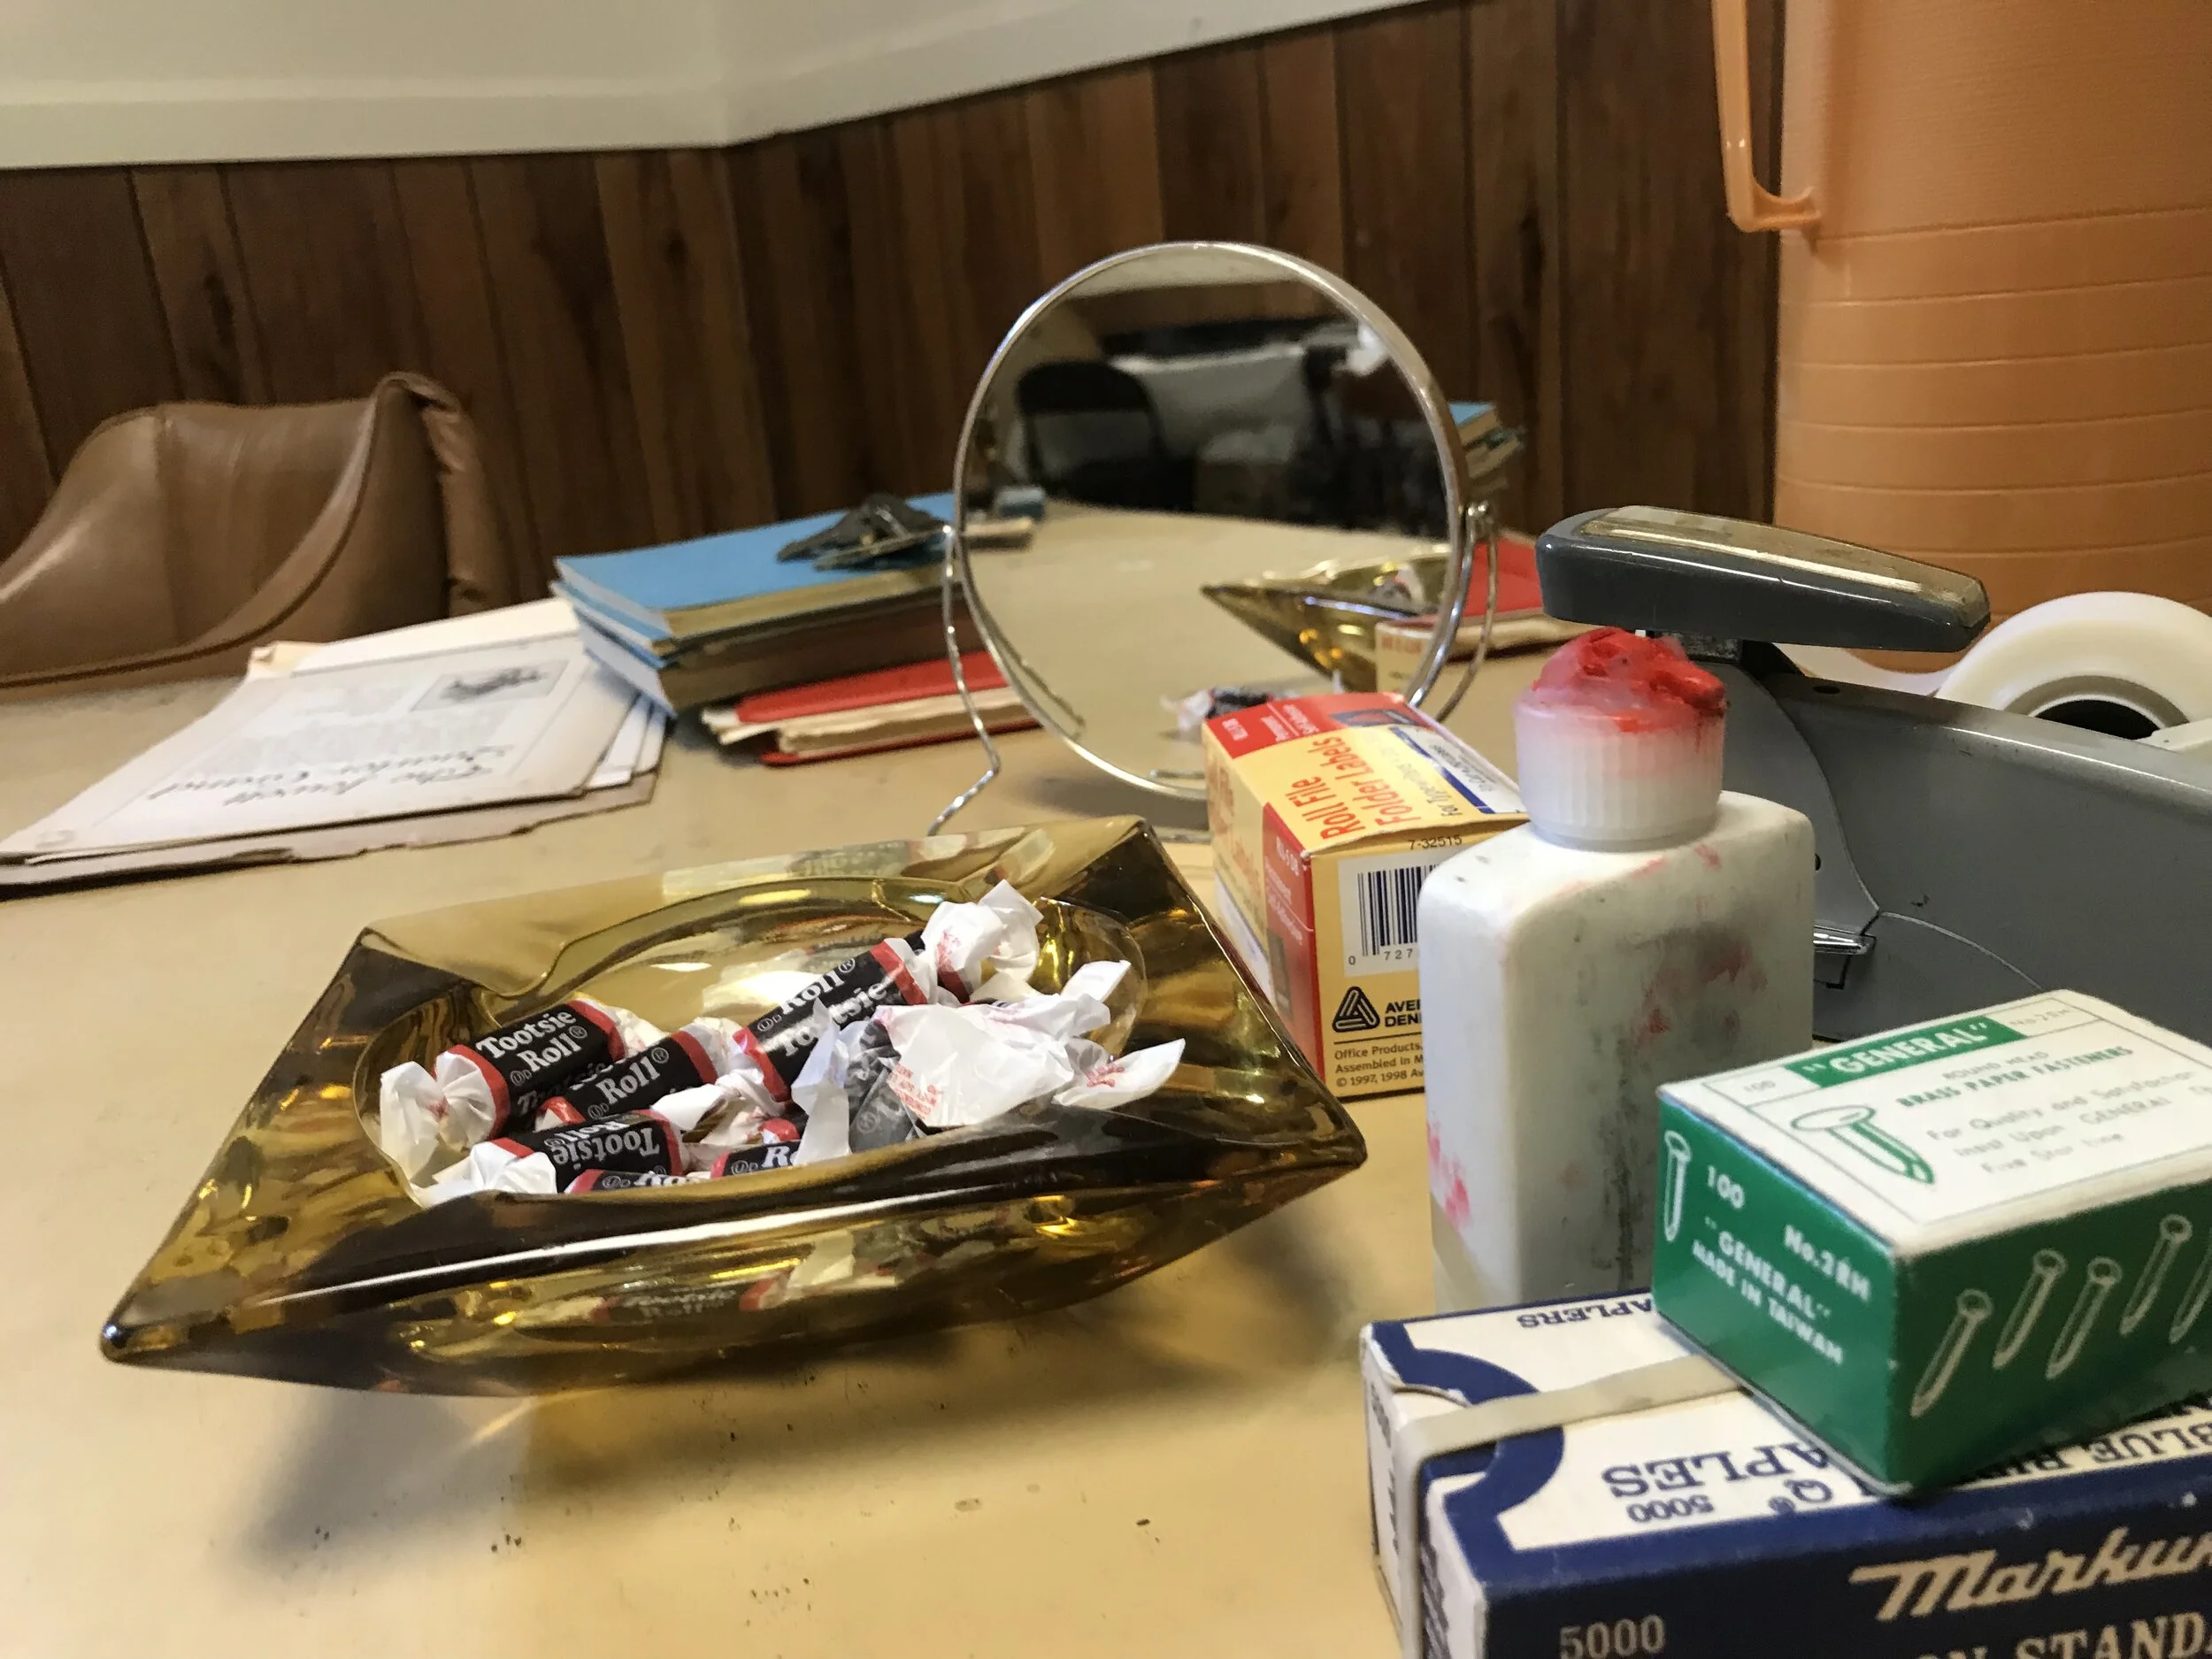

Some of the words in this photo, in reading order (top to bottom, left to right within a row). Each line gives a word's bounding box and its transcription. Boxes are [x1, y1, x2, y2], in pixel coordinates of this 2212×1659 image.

[1308, 736, 1374, 780] Labels
[1285, 776, 1337, 807] File
[1351, 779, 1422, 826] Folder
[1302, 802, 1366, 840] Roll
[1438, 804, 1463, 817] For
[1407, 834, 1463, 850] 7-32515
[476, 1010, 577, 1059] Tootsie
[1385, 1013, 1423, 1028] DEN
[1334, 1047, 1369, 1061] Office
[1335, 1056, 1397, 1073] Assembled
[1400, 1056, 1411, 1065] in
[1350, 1073, 1378, 1087] 1997,
[1381, 1070, 1408, 1083] 1998
[1896, 1087, 1962, 1107] BRASS
[1963, 1071, 2031, 1091] PAPER
[2031, 1046, 2134, 1074] FASTENERS
[1969, 1108, 2044, 1130] Quality
[2051, 1095, 2089, 1110] and
[2079, 1095, 2172, 1125] GENERAL
[549, 1127, 661, 1171] Tootsie
[1708, 1164, 1746, 1210] 100
[1691, 1239, 1736, 1287] MADE
[1740, 1279, 1762, 1308] IN
[1767, 1295, 1845, 1365] TAIWAN
[1626, 1494, 1715, 1524] 5000
[1559, 1613, 1666, 1659] 5000
